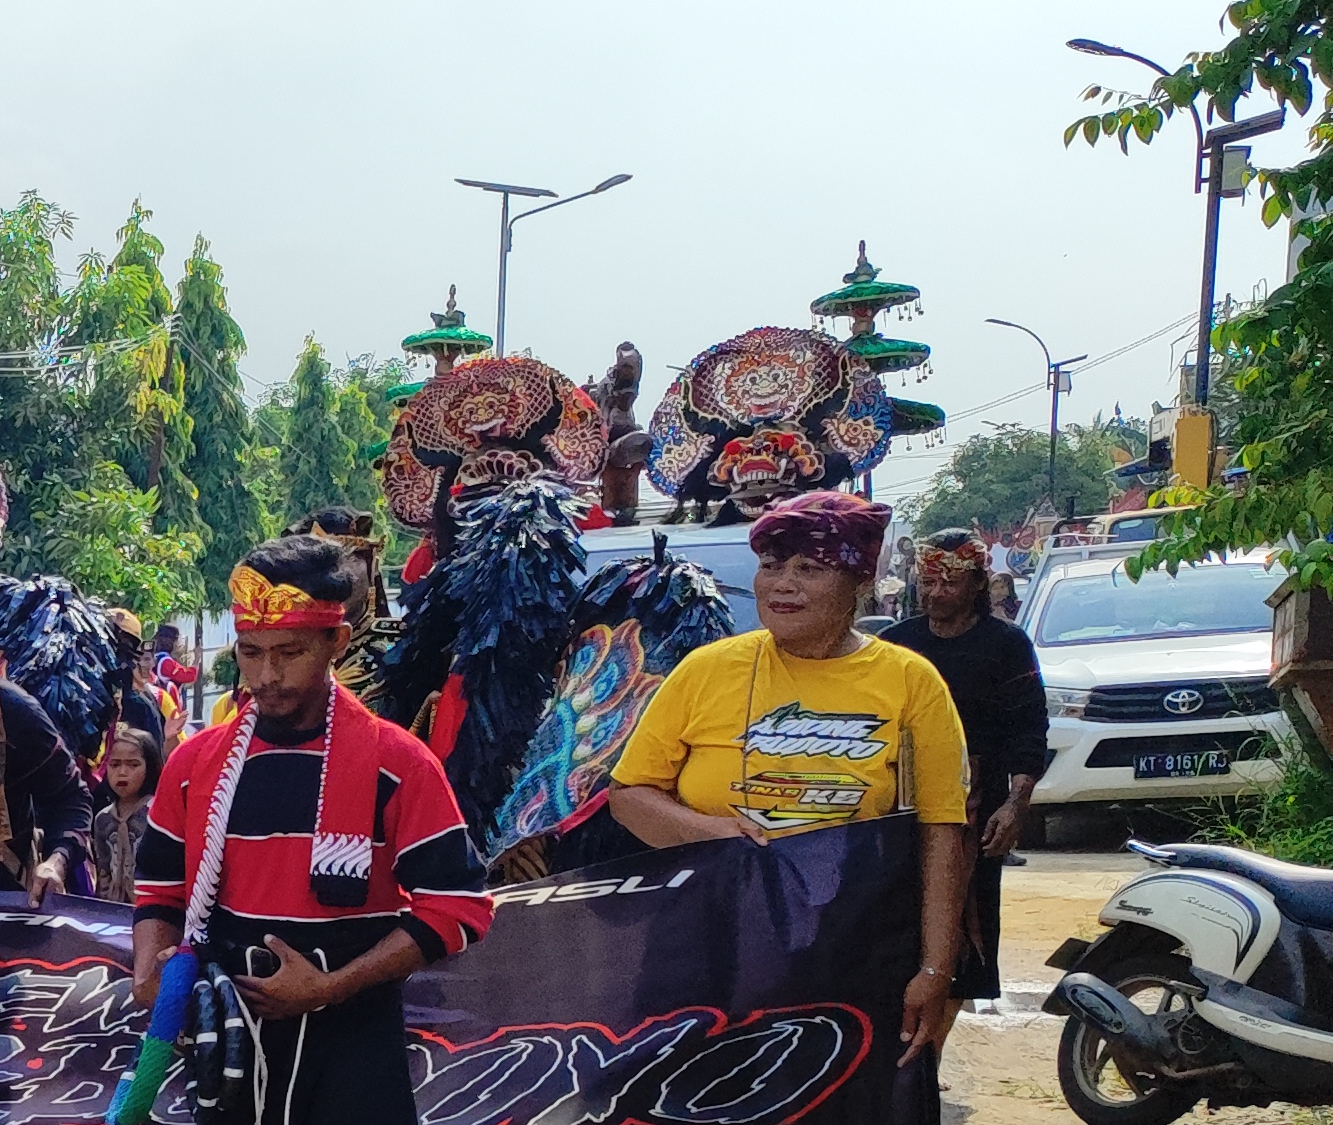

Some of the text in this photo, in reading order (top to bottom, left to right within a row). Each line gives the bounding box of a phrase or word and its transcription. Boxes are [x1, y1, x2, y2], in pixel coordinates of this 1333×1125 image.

[1139, 756, 1156, 772] KT
[1165, 755, 1199, 770] 8161
[492, 869, 695, 908] ASLI
